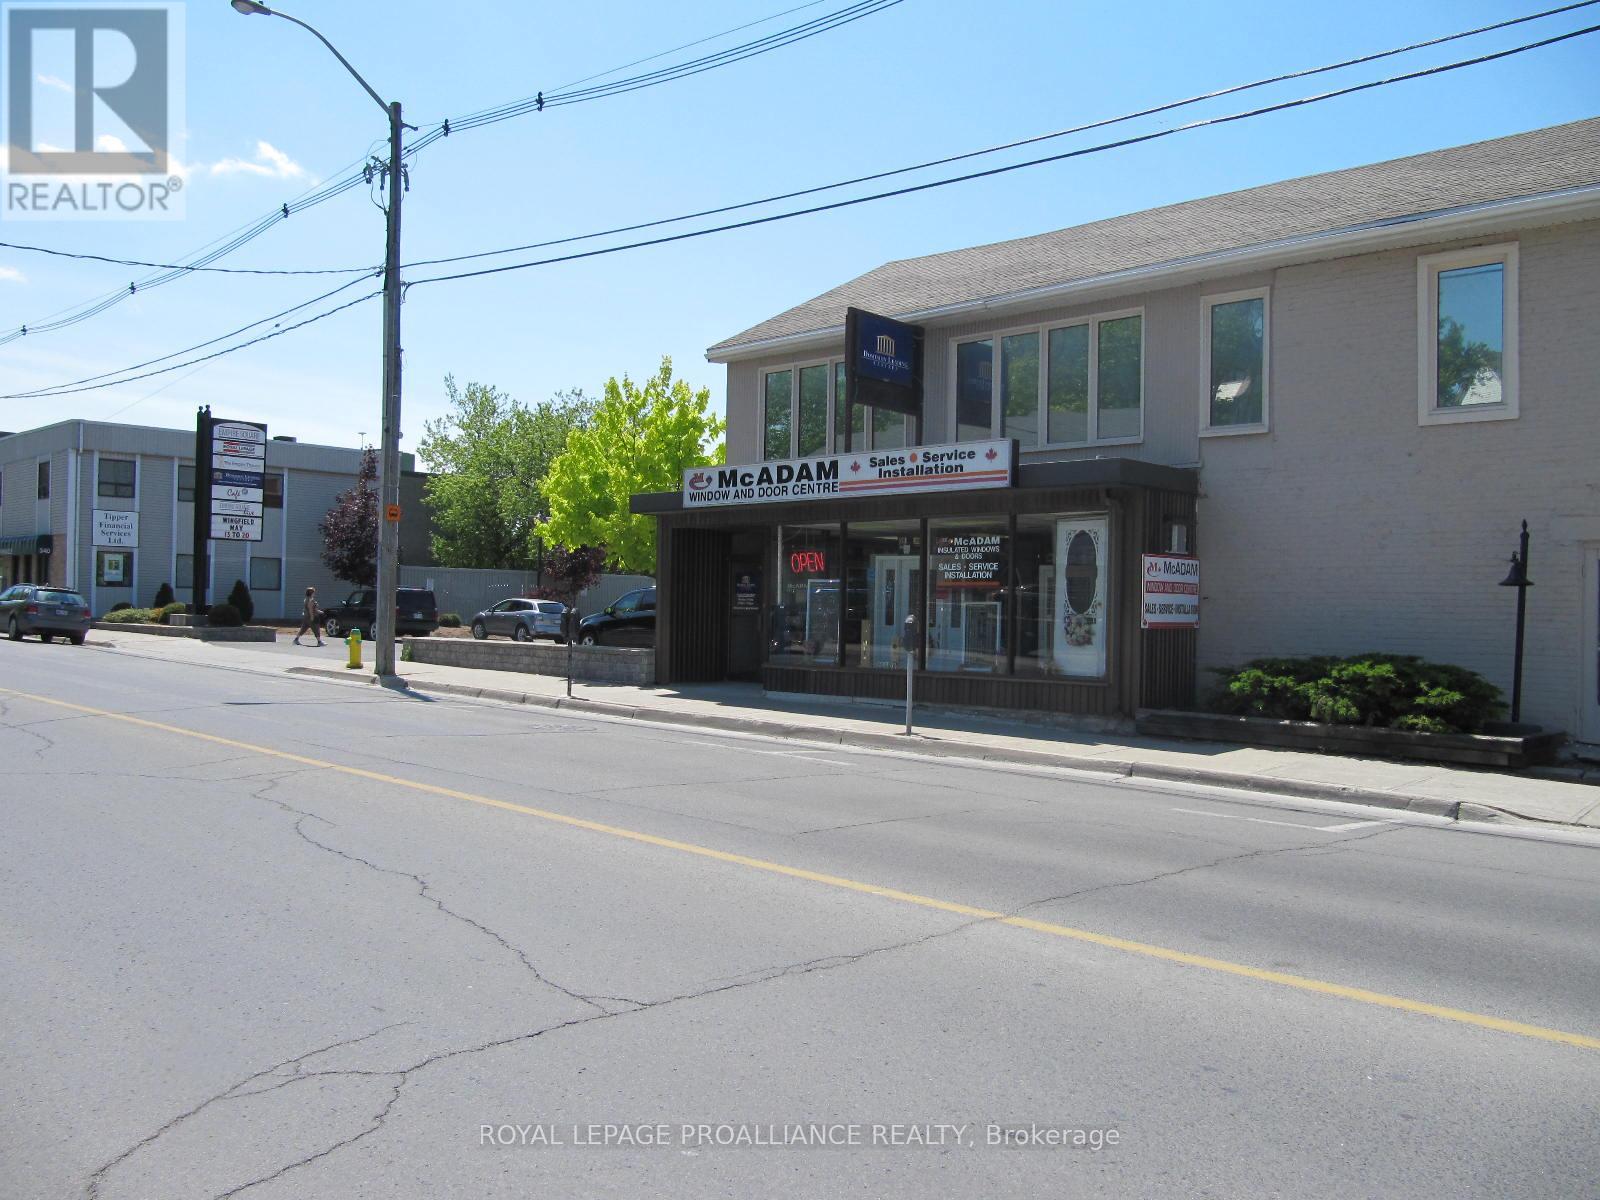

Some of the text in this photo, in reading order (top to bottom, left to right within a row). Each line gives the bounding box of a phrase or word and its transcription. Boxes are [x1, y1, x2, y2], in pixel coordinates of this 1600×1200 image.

[869, 449, 976, 468] Sales Service
[718, 460, 839, 488] McADAM
[878, 463, 964, 479] Installation
[689, 482, 839, 502] WINDOW AND DOOR CENTRE
[103, 512, 129, 521] Tipper
[222, 517, 255, 525] WINGFIELD
[99, 521, 133, 530] Financial
[230, 524, 243, 532] MAY
[108, 537, 124, 545] Ltd.
[954, 536, 1000, 546] McADAM
[937, 545, 1000, 554] INSULATED WINDOWS
[791, 552, 825, 573] OPEN
[938, 562, 999, 571] SALES SERVICE
[1163, 561, 1198, 577] McADAM
[944, 571, 993, 579] INSTALLATION
